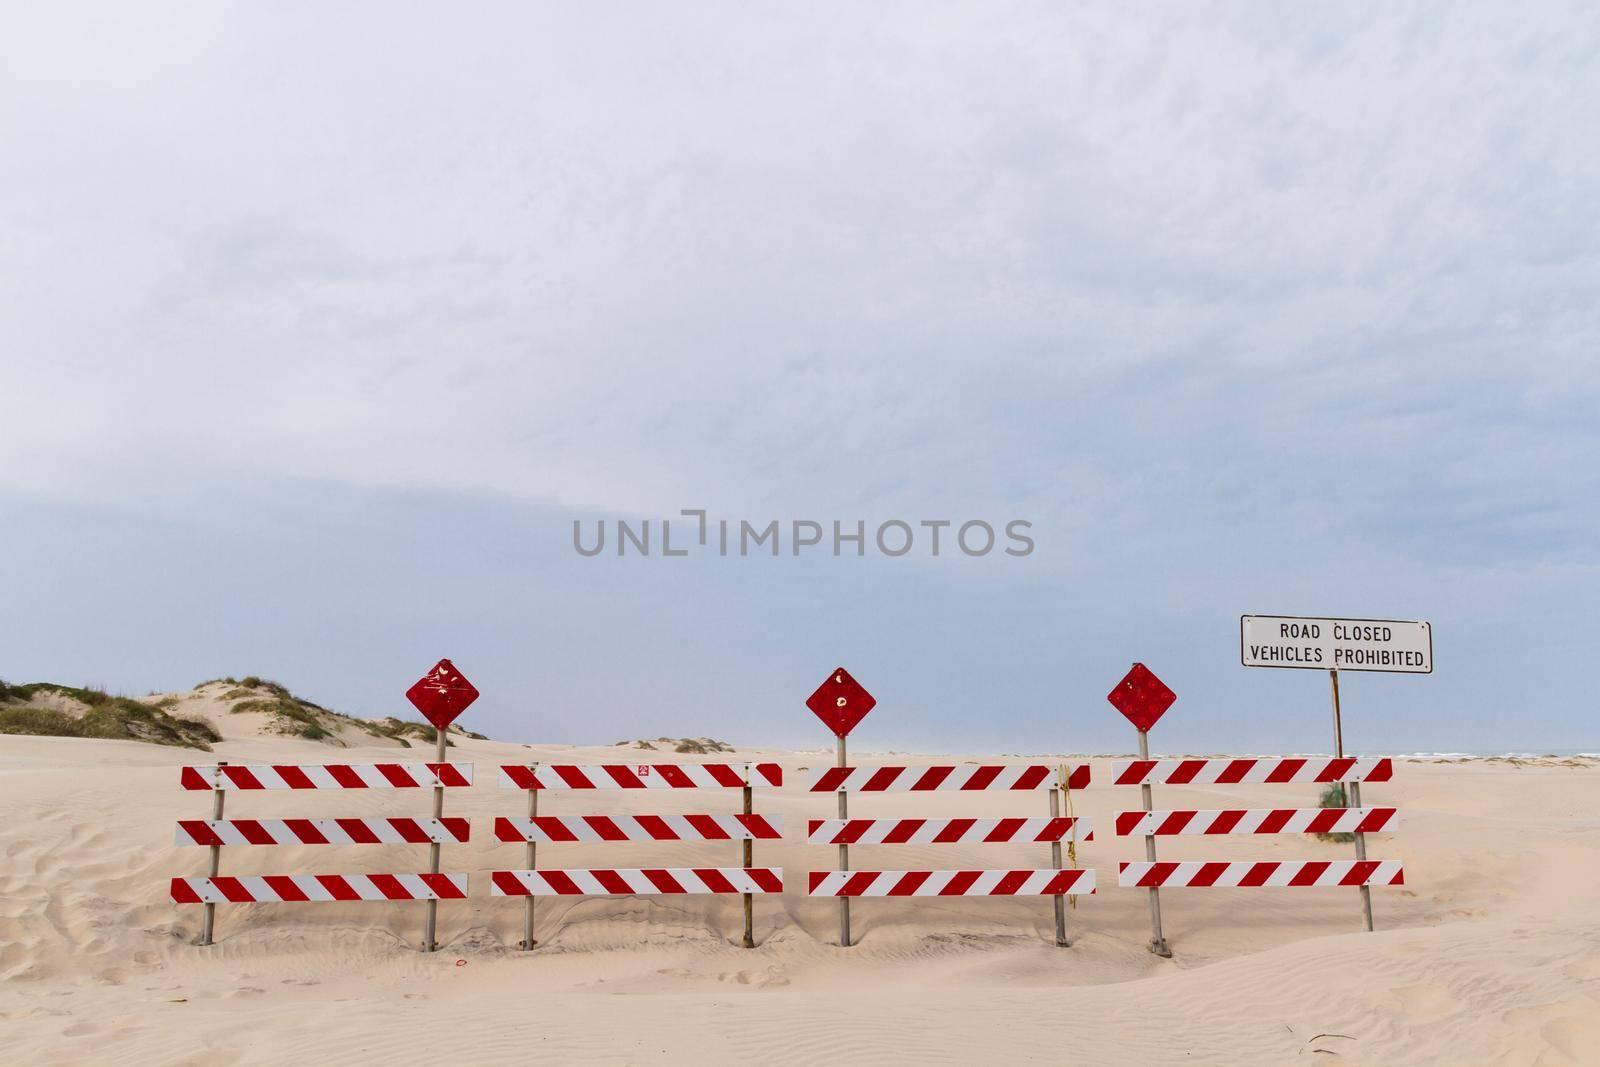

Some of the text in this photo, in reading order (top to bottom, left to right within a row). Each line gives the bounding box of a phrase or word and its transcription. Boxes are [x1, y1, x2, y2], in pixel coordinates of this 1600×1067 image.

[1280, 623, 1392, 642] ROAD CLOSED
[1250, 645, 1424, 667] VEHICLES PROHIBITED
